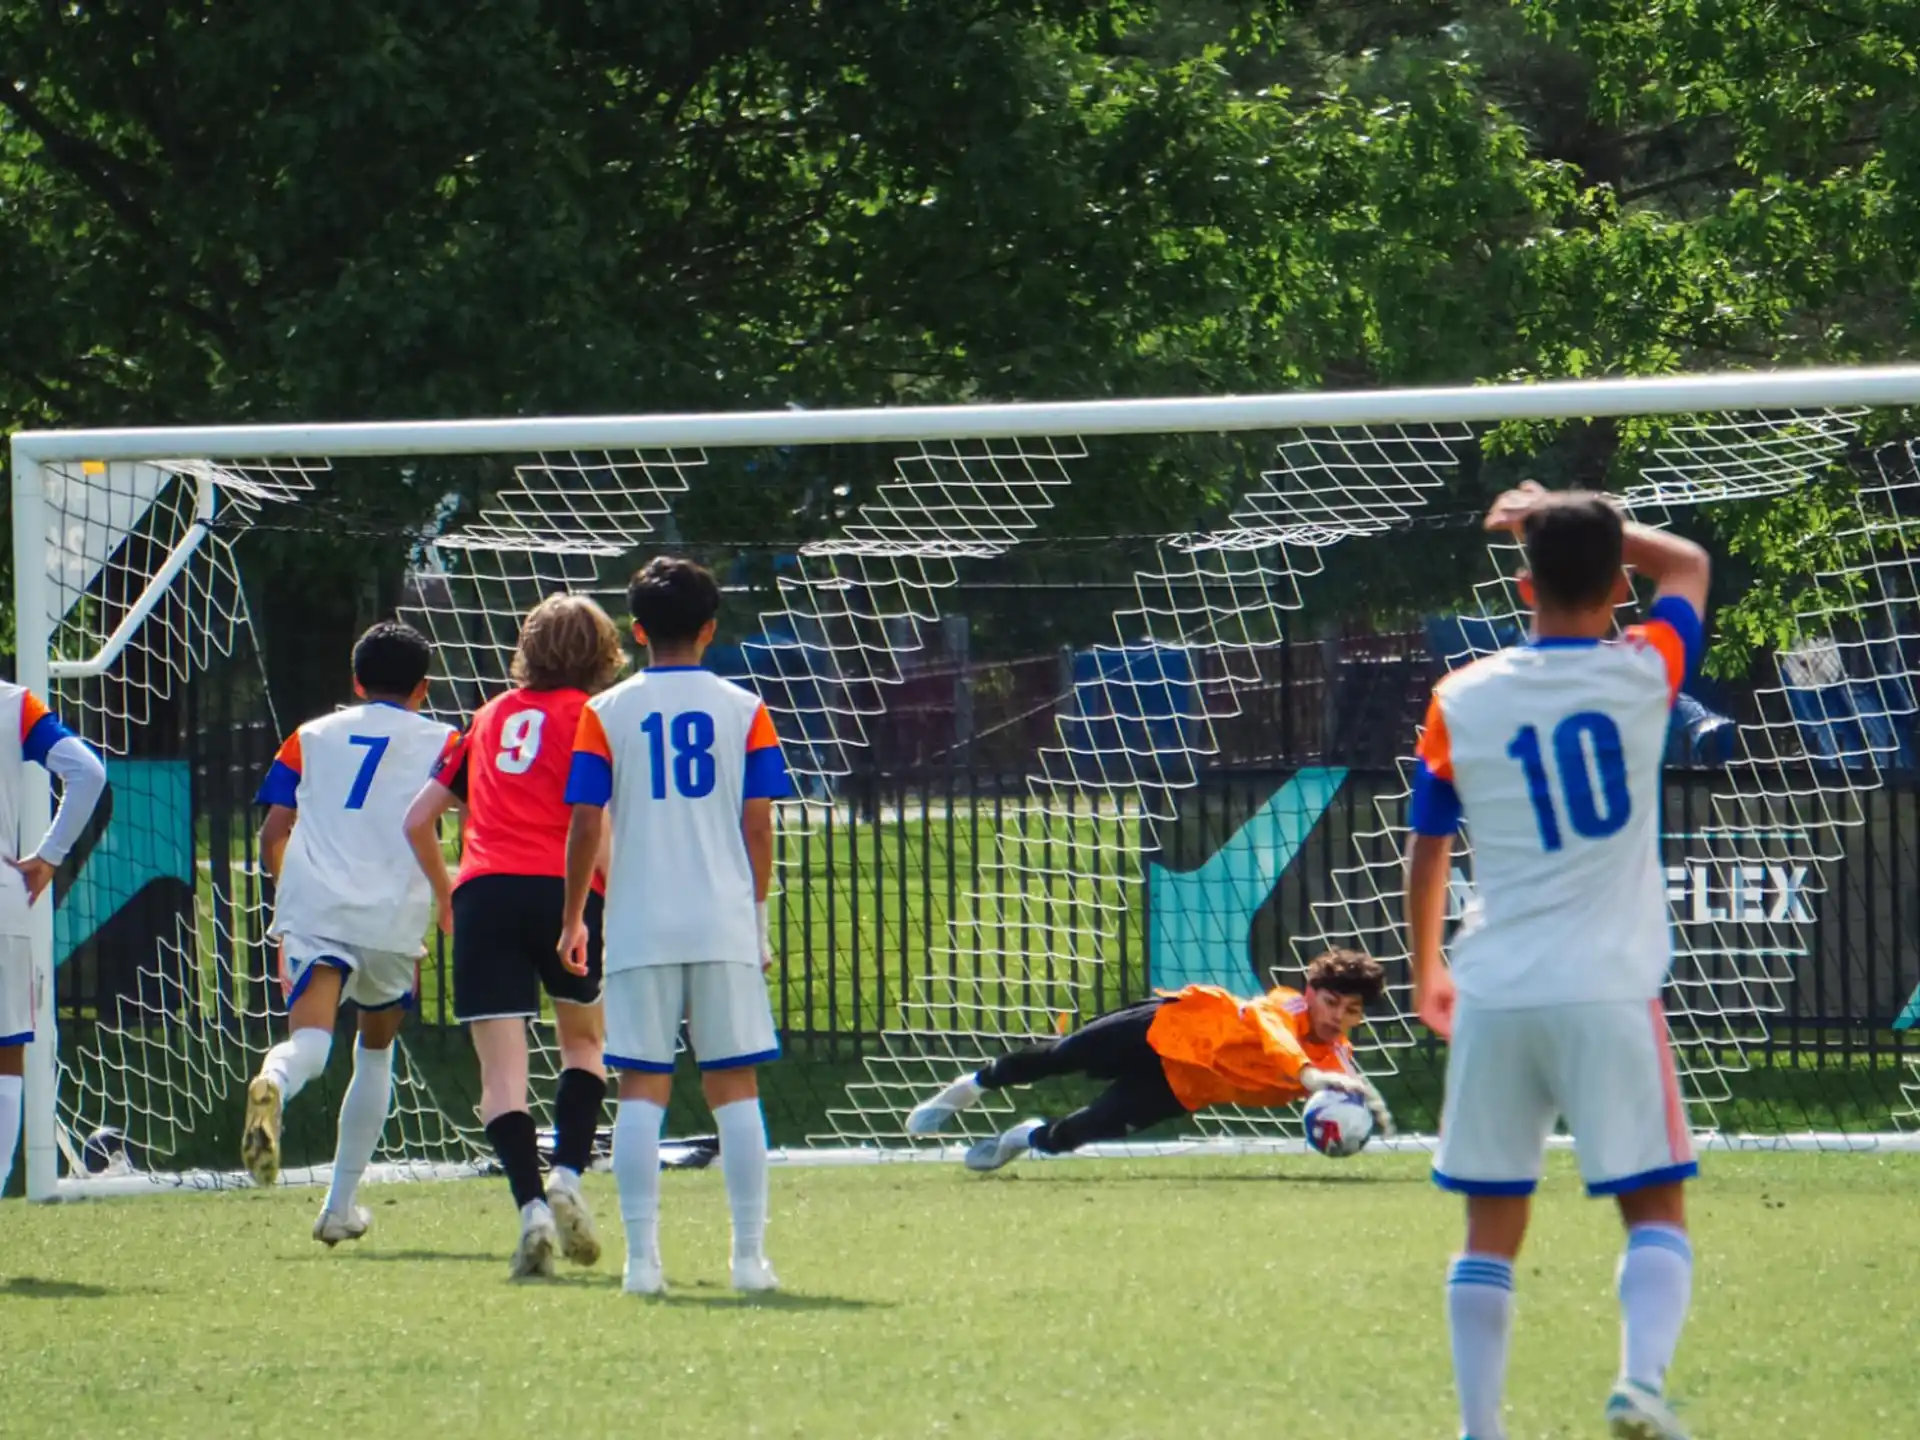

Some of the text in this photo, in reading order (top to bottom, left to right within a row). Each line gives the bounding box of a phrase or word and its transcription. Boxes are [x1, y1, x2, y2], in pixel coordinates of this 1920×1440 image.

[344, 734, 391, 811] 7
[495, 709, 546, 775] 9
[640, 710, 717, 801] 18
[1505, 709, 1633, 854] 10
